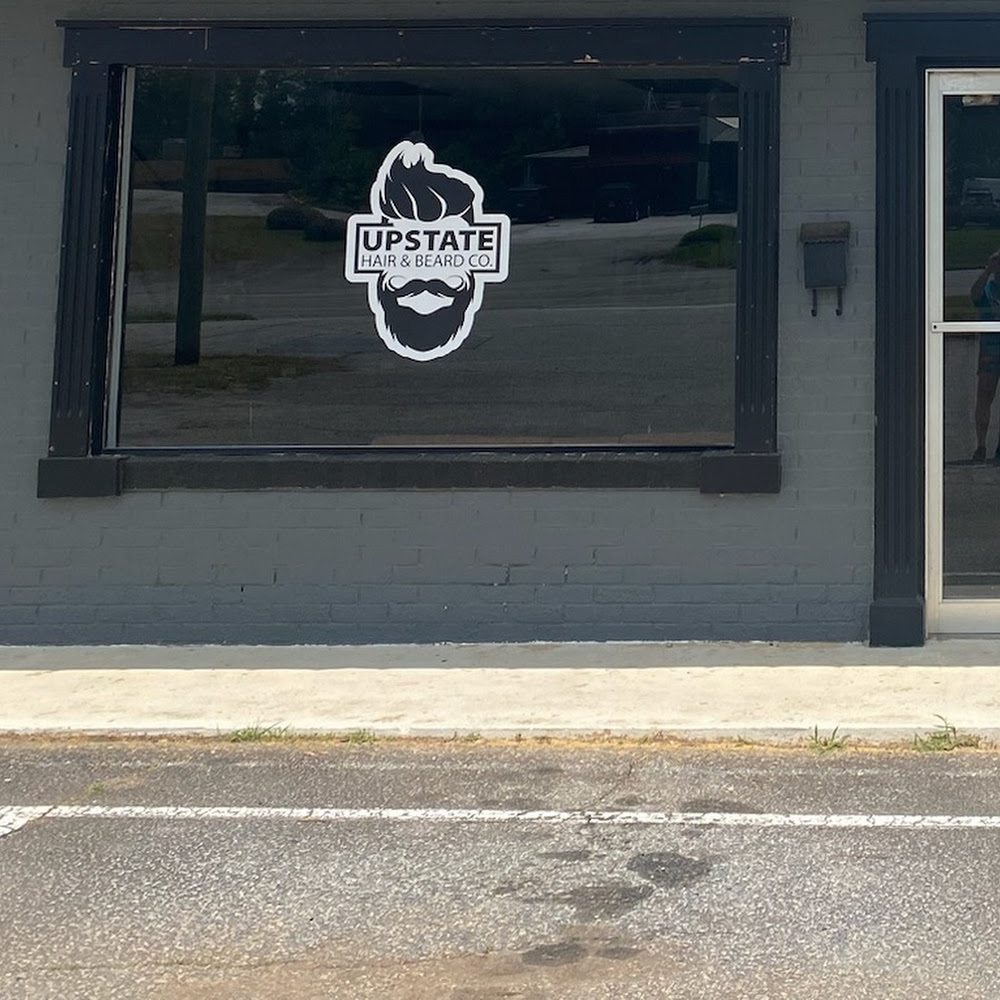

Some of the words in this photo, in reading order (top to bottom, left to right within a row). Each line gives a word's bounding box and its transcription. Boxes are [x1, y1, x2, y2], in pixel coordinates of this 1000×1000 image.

[363, 229, 494, 251] UPSTATE
[361, 254, 397, 268] HAIR
[400, 254, 411, 268] &
[415, 254, 464, 268] BEARD
[468, 254, 494, 268] CO.
